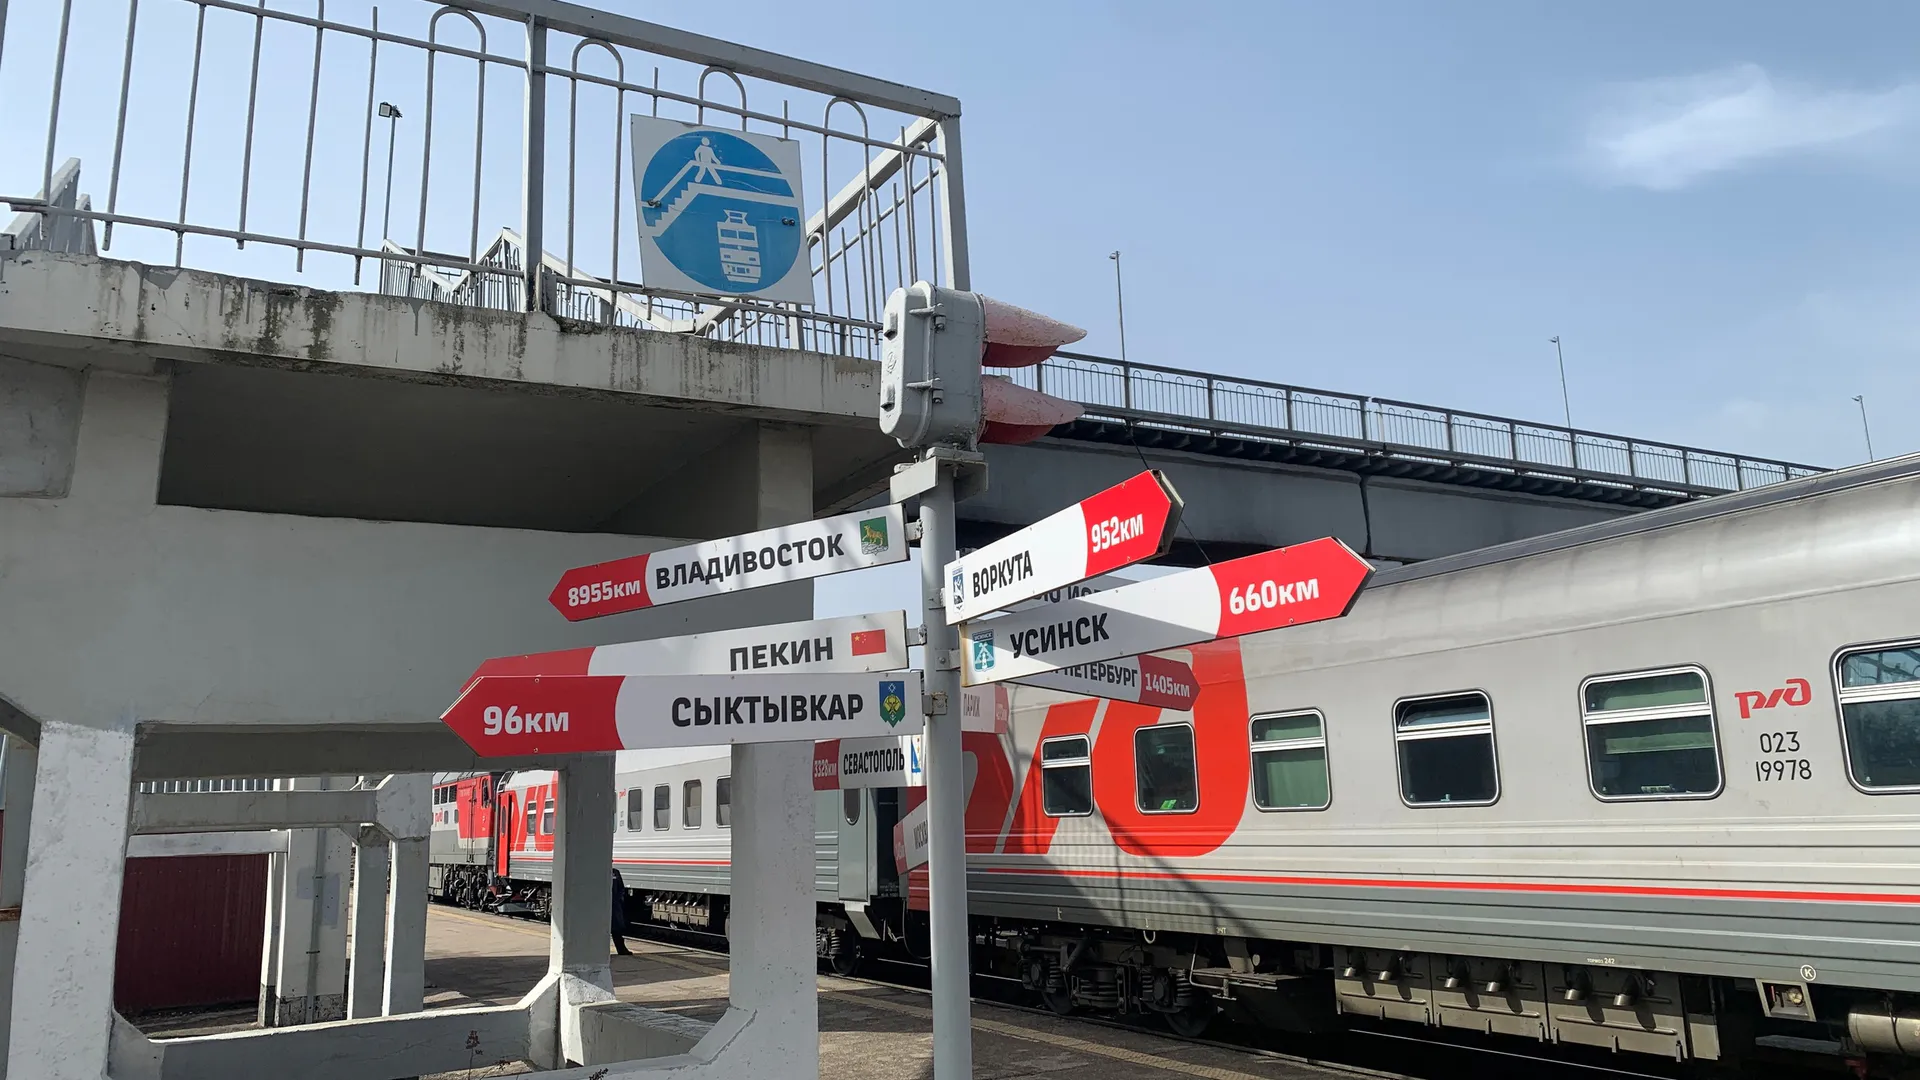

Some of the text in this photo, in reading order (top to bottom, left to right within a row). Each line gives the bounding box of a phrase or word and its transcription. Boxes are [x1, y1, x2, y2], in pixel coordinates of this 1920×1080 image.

[568, 533, 844, 607] 8955км ВЛАДИВОСТОК
[972, 550, 1034, 598] ВОРКУТА
[1009, 578, 1320, 659] УСИНСК 660км
[730, 637, 833, 672] ПЕКИН
[483, 694, 863, 735] 96км СЫКТЫВКАР
[1734, 678, 1812, 719] РЖД
[843, 747, 905, 775] СЕВАСТОПОЛЬ
[1760, 731, 1800, 753] 023
[1756, 759, 1812, 782] 19978
